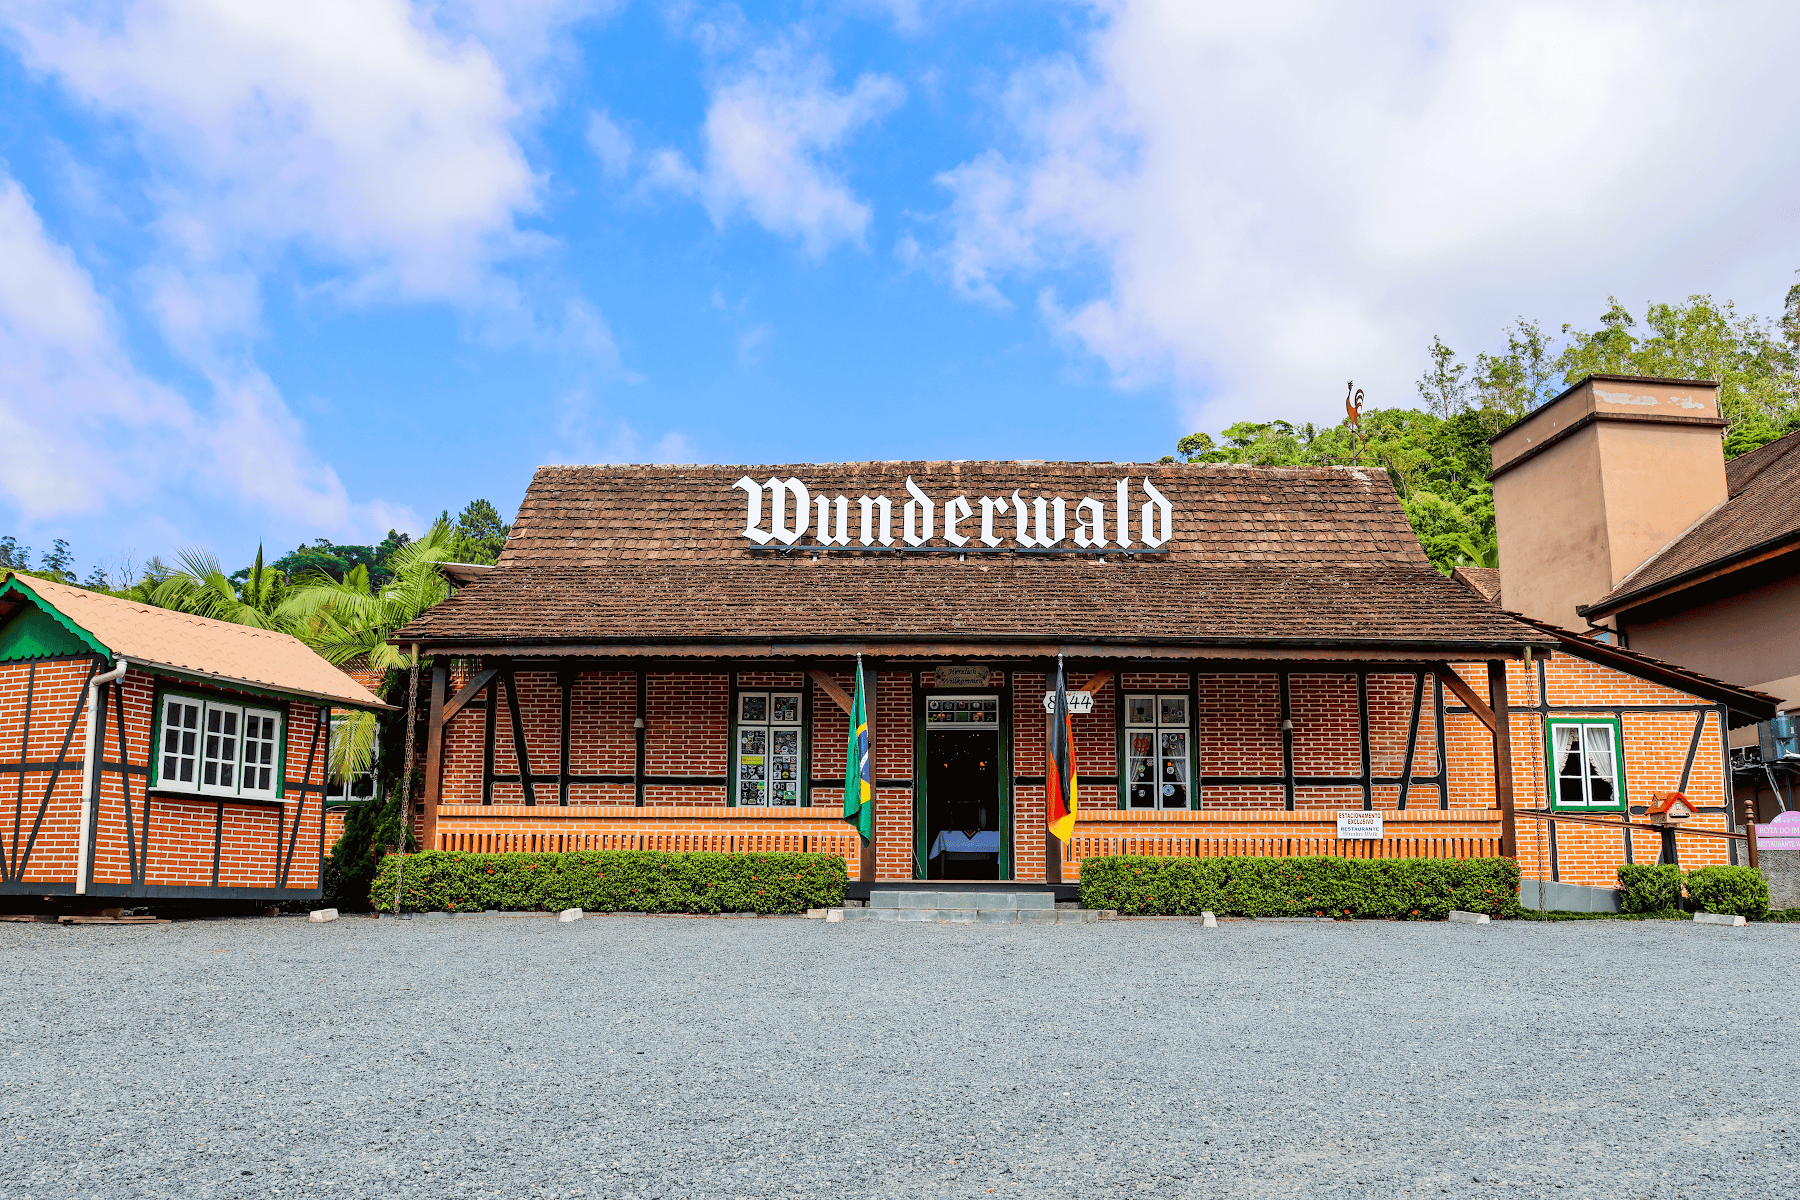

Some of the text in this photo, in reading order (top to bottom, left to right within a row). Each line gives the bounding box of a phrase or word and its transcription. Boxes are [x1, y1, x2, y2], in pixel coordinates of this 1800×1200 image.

[731, 474, 1174, 549] Wunderwald
[948, 667, 977, 675] Herzlich
[1047, 695, 1092, 710] 844
